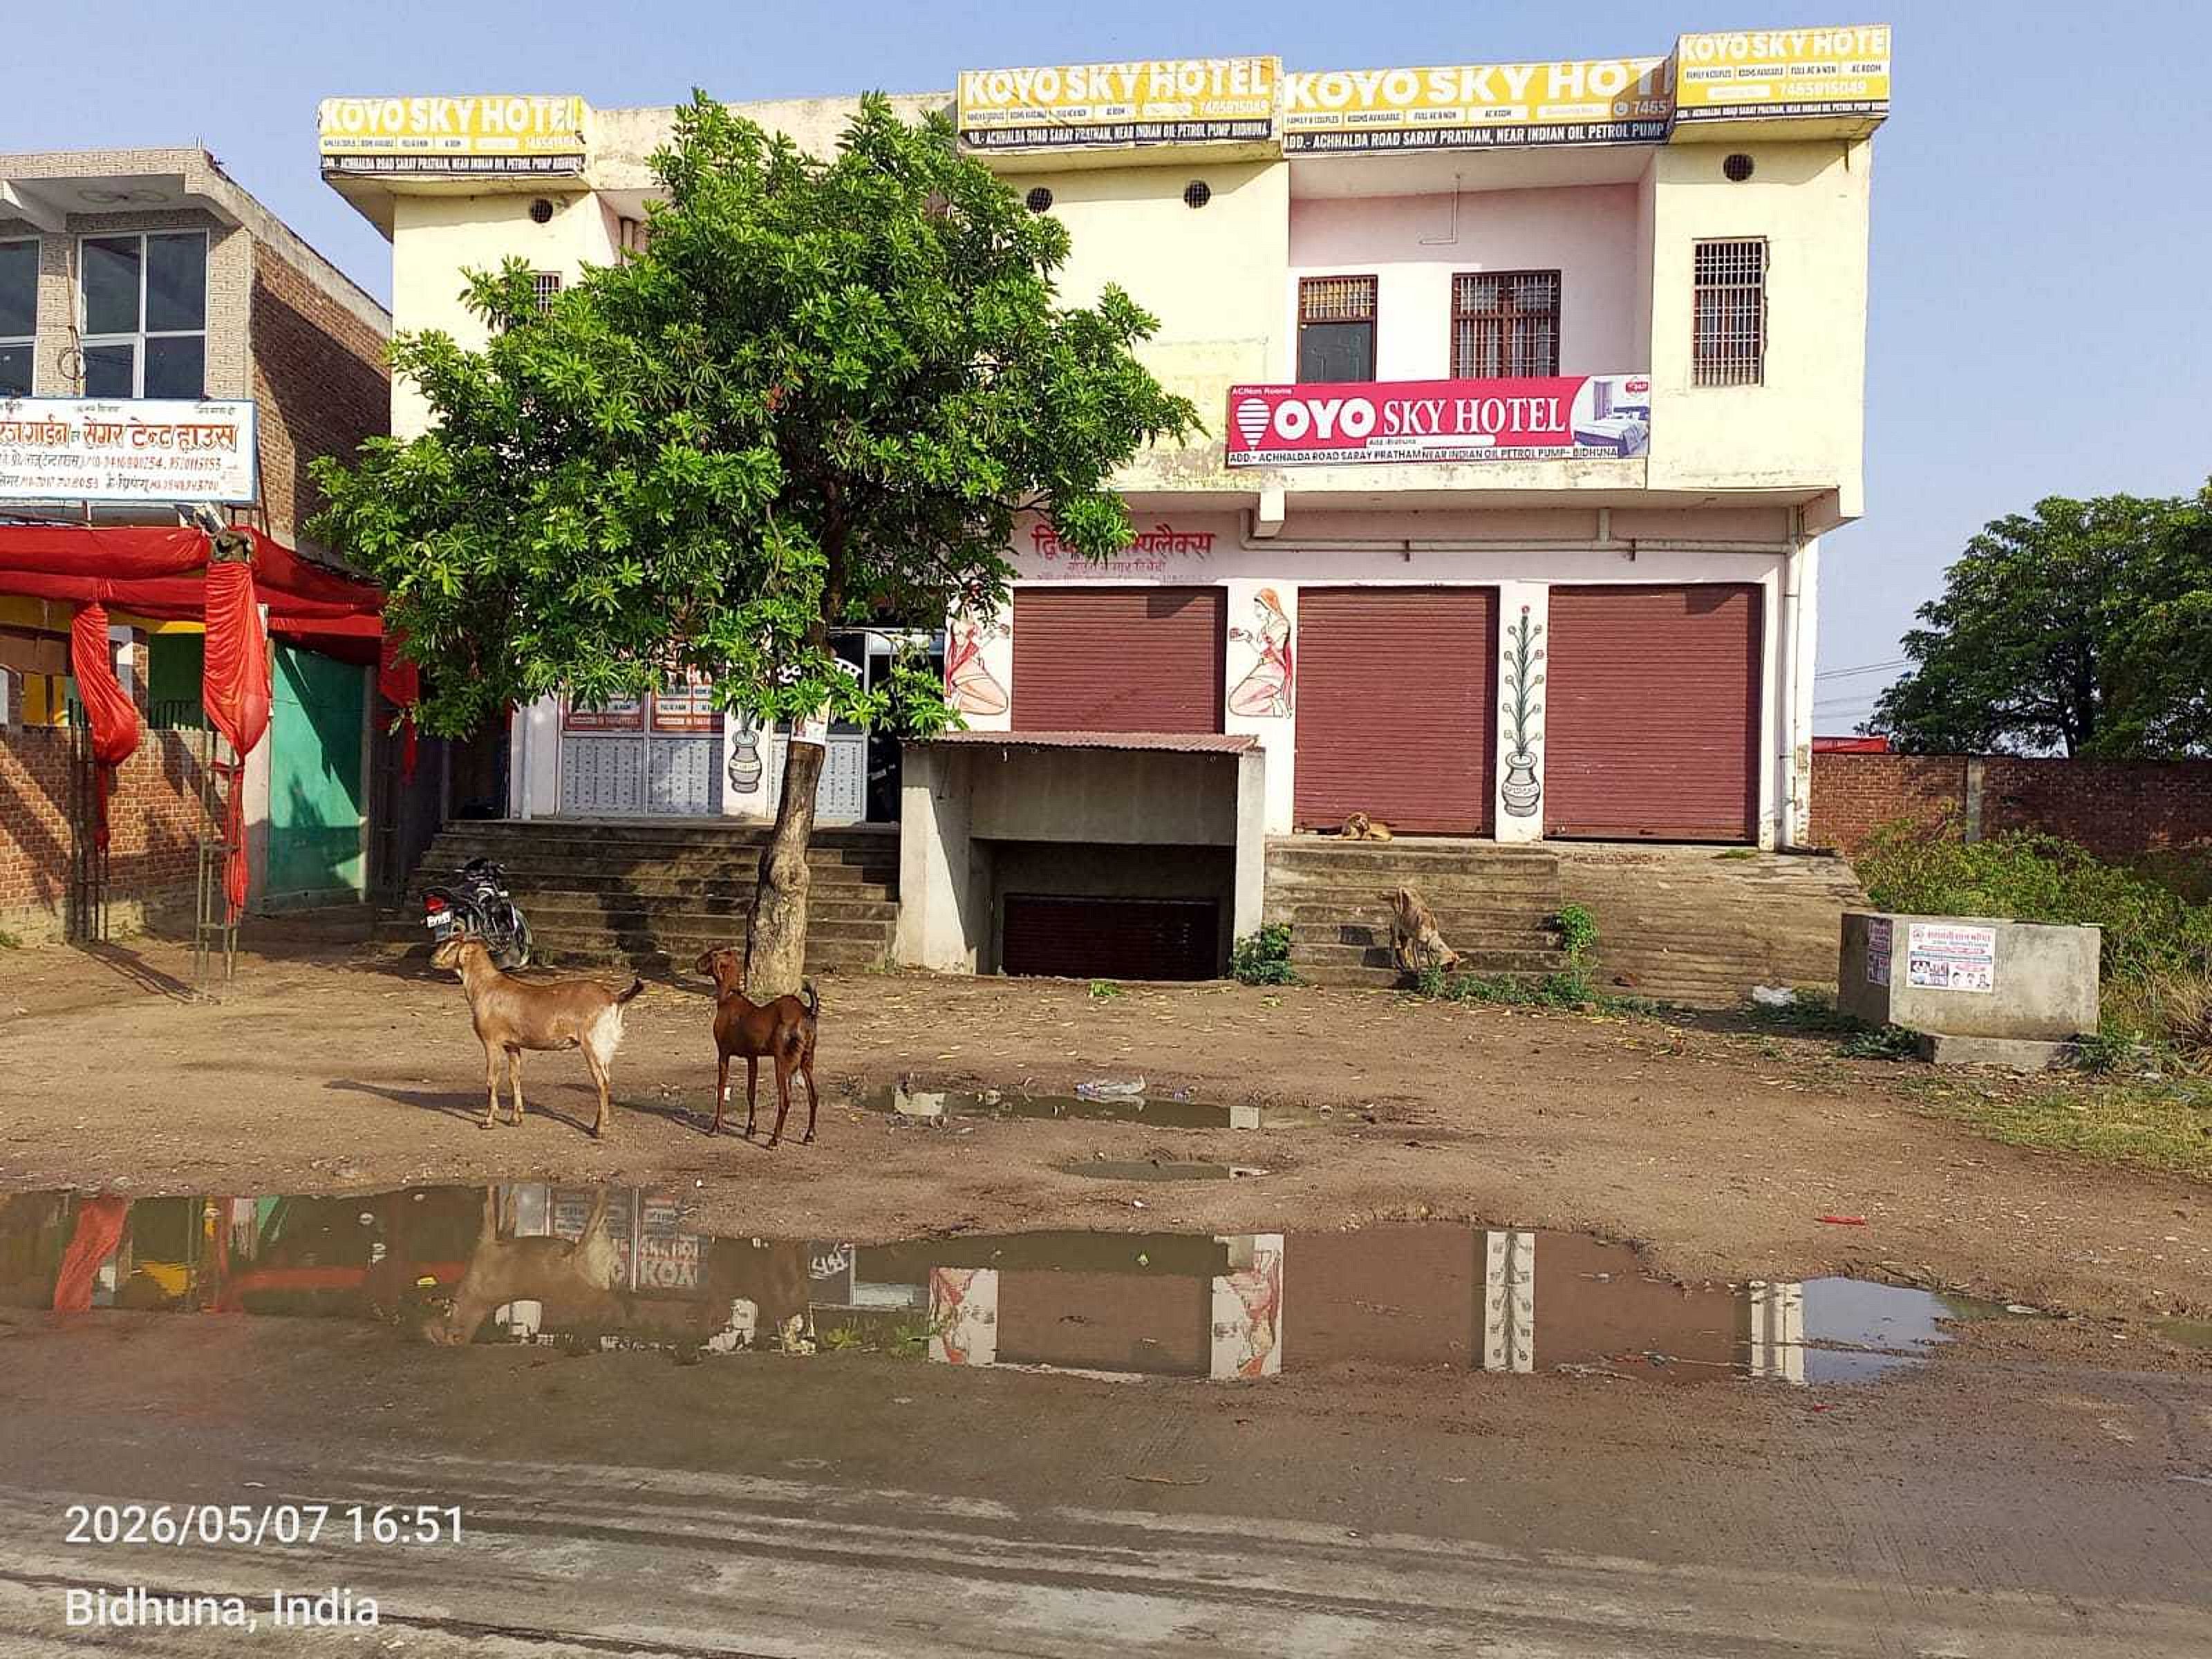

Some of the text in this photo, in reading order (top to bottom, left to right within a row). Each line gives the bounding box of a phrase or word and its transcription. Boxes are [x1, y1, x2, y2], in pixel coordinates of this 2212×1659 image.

[1753, 31, 1808, 58] SKY
[966, 58, 1272, 104] KOYO SKY HOTEL
[1284, 69, 1419, 109] KOYO
[1427, 65, 1536, 104] SKY
[409, 98, 473, 133] SKY
[1371, 132, 1400, 147] ROAD
[1403, 131, 1438, 146] SARAY
[1497, 127, 1525, 143] NEAR
[1528, 126, 1565, 142] INDIAN
[1568, 124, 1585, 140] OIL
[1588, 122, 1628, 139] PETROL
[1632, 121, 1664, 138] PUMP
[1274, 397, 1566, 440] OYO SKY HOTEL
[1313, 451, 1340, 462] ROAD
[1573, 447, 1618, 458] BIDHUNA
